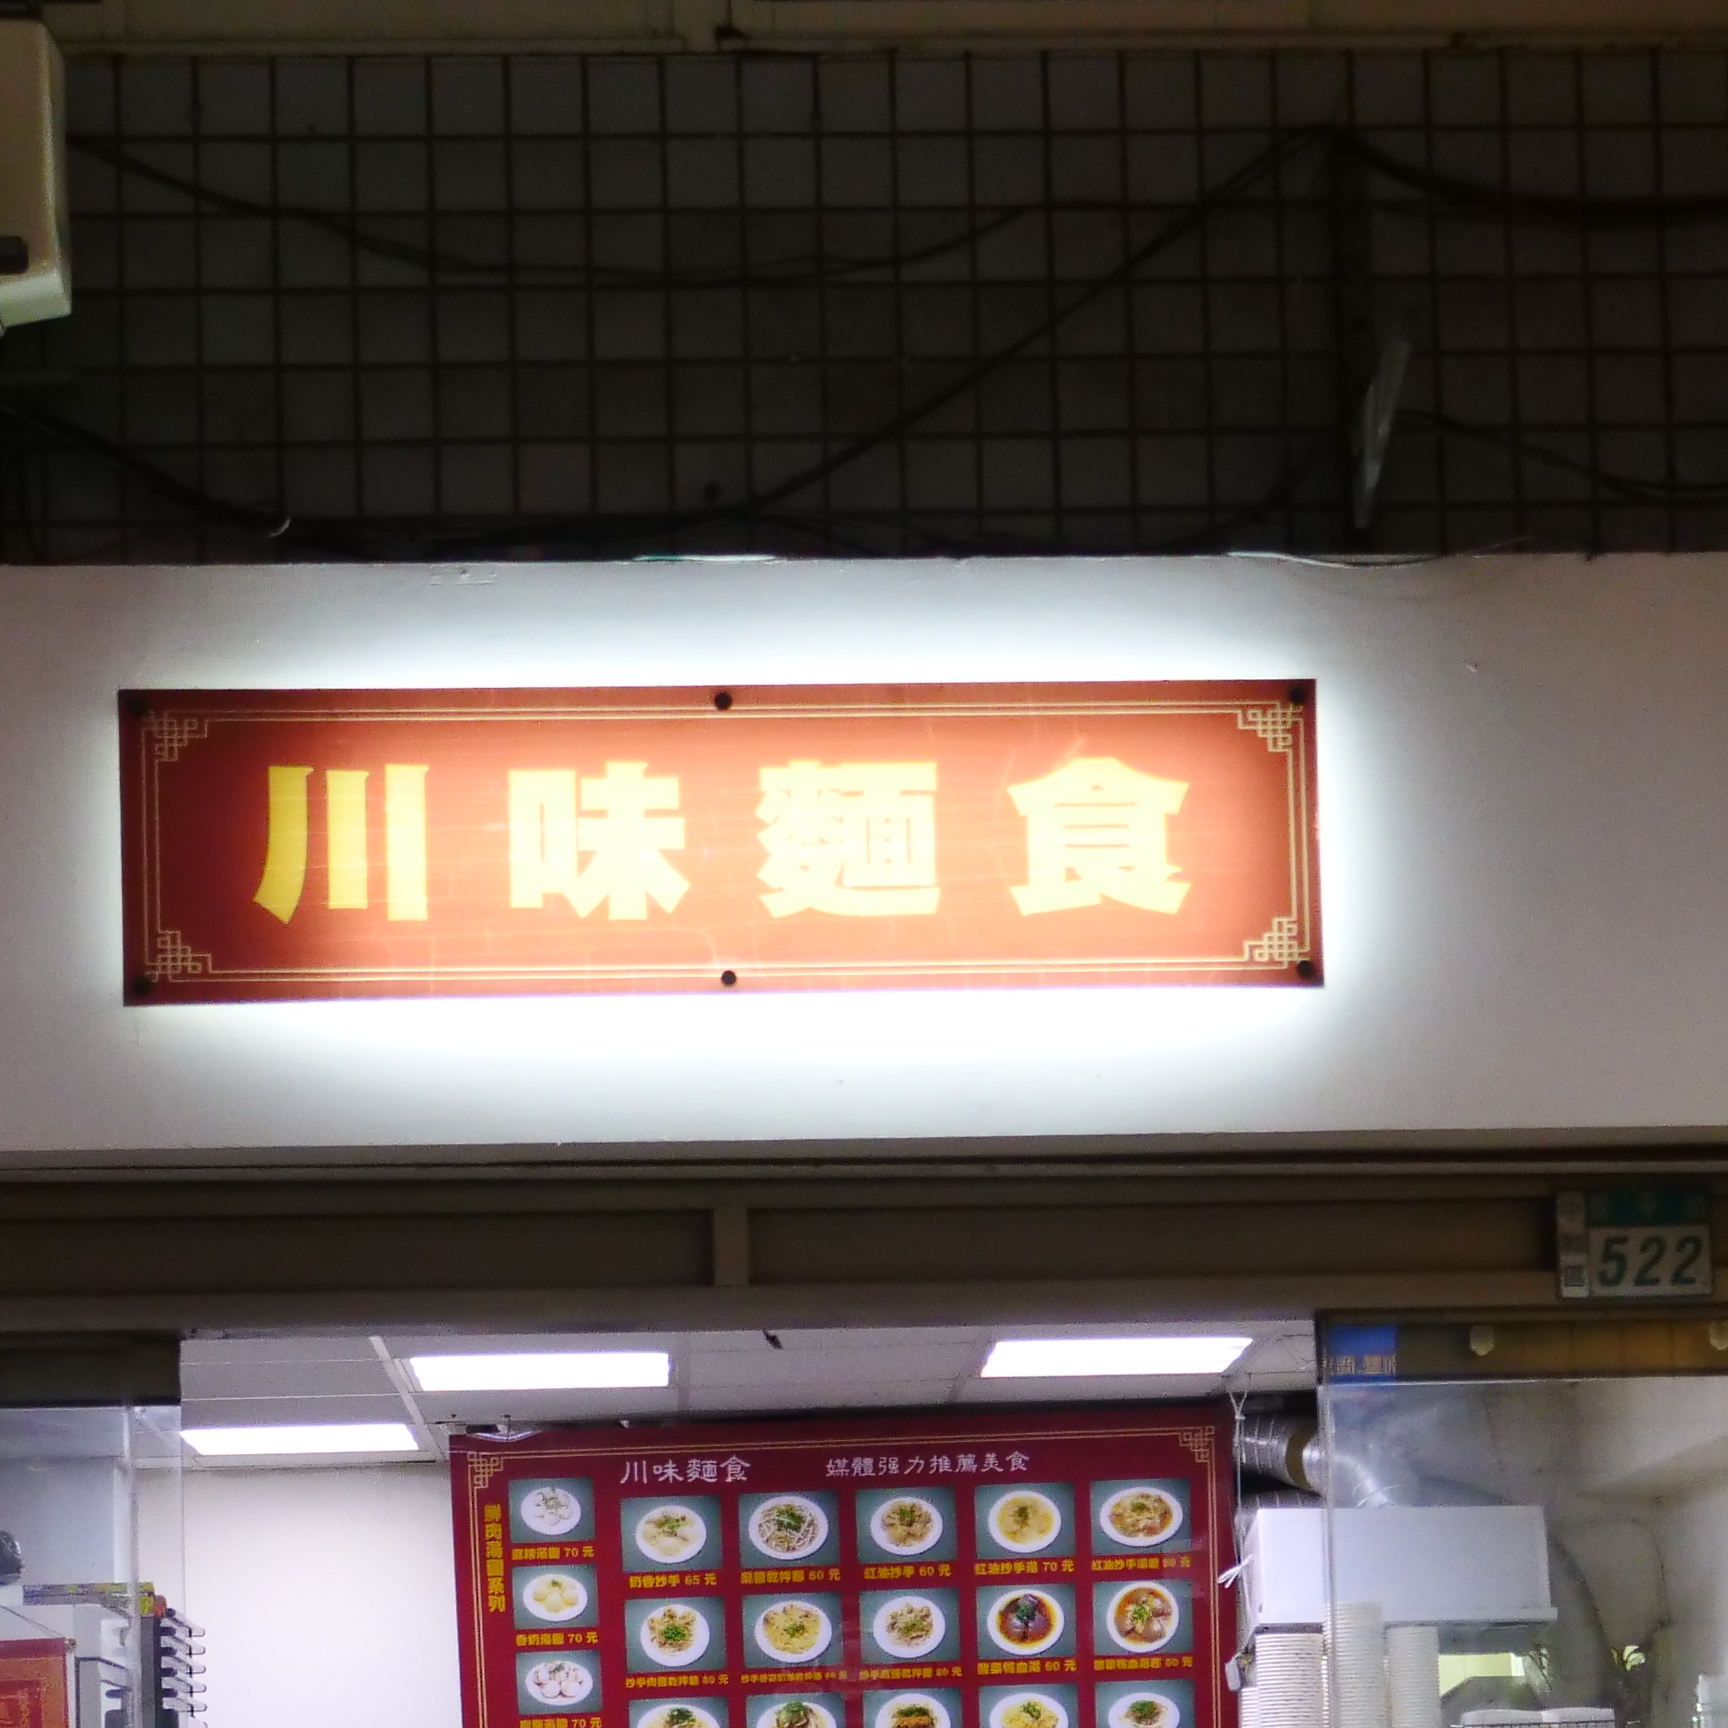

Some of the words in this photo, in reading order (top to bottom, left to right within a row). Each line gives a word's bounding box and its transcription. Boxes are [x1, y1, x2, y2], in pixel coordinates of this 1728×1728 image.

[253, 756, 1193, 924] 川味麵食
[1597, 1235, 1703, 1288] 522
[620, 1454, 751, 1484] 川味麵食
[564, 1547, 579, 1558] 70
[582, 1545, 594, 1558] 元
[1043, 1561, 1058, 1572] 70
[1061, 1559, 1075, 1572] 元
[1180, 1556, 1191, 1568] 元
[829, 1568, 840, 1580] 元
[938, 1564, 951, 1577] 元
[704, 1572, 717, 1586] 元
[567, 1633, 583, 1644] 70
[586, 1631, 599, 1645] 元
[1064, 1659, 1077, 1672] 元
[1182, 1656, 1193, 1667] 元
[838, 1670, 848, 1681] 元
[952, 1666, 962, 1677] 元
[718, 1674, 729, 1685] 元
[571, 1718, 587, 1728] 70
[590, 1716, 602, 1728] 元
